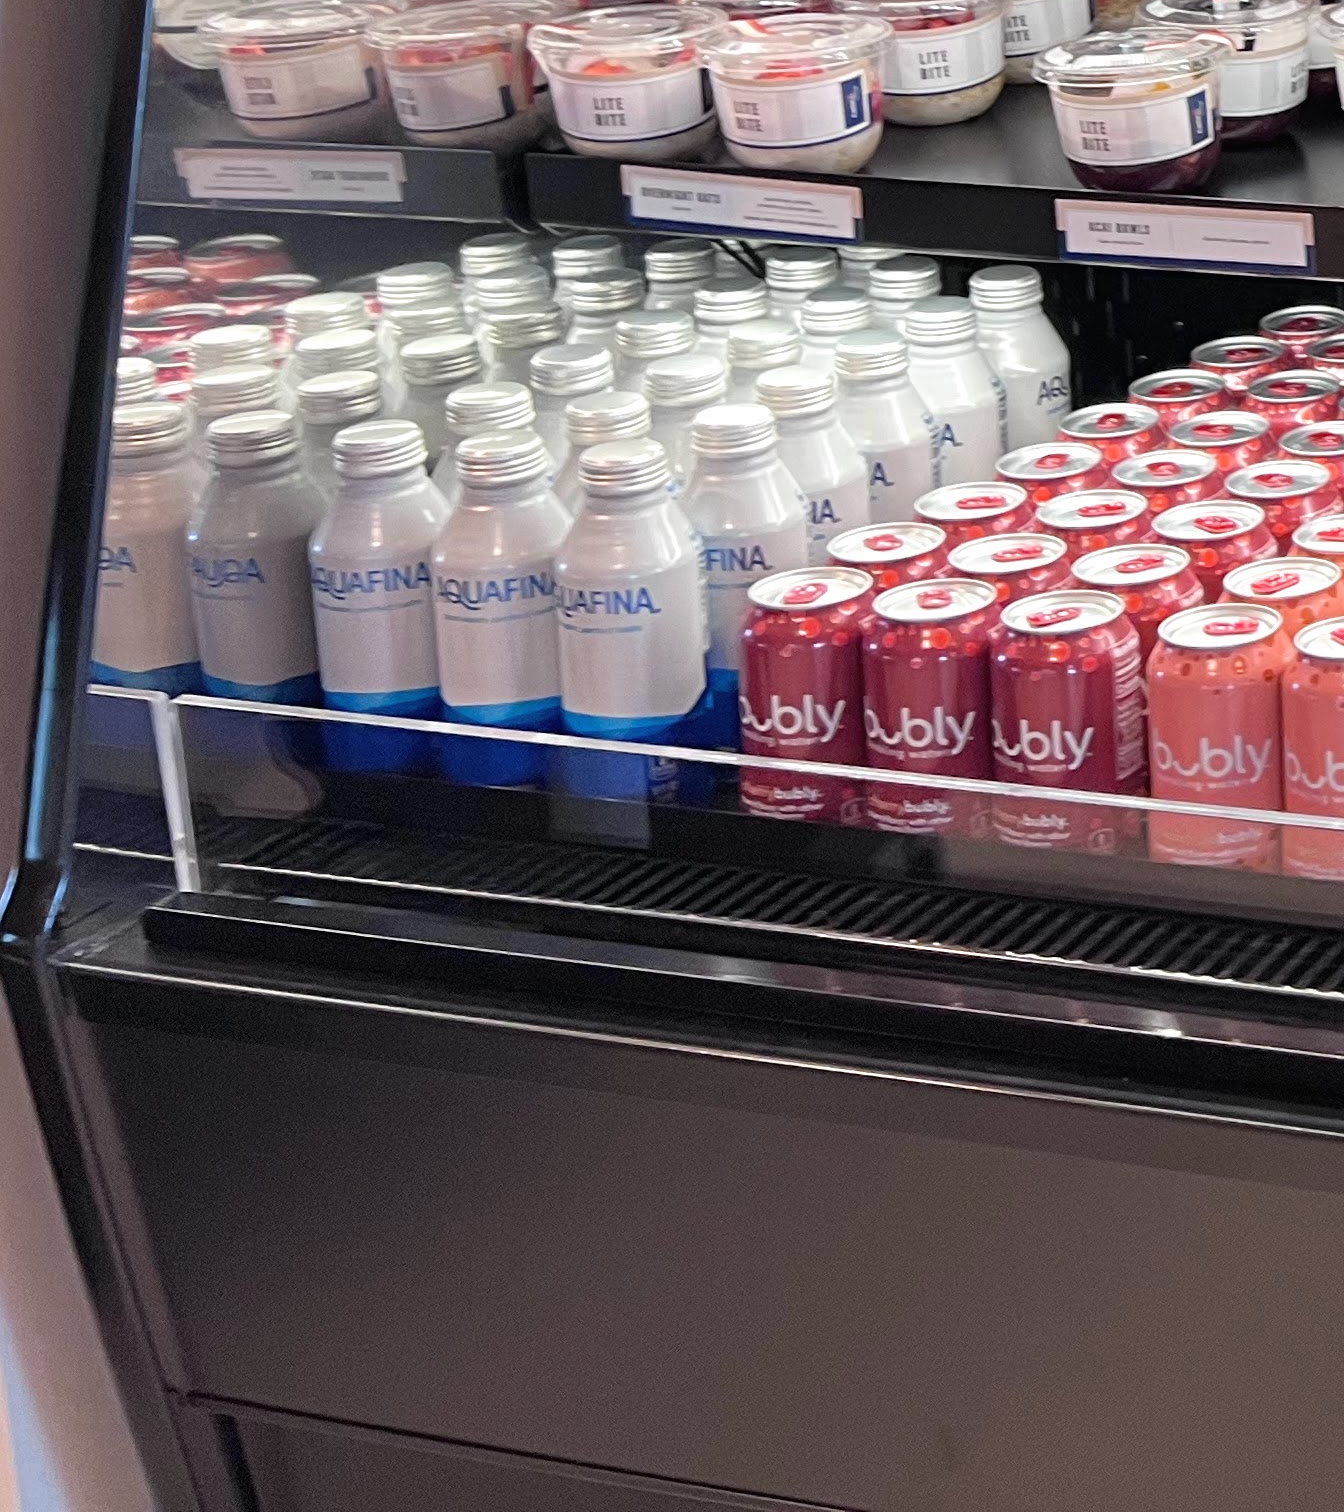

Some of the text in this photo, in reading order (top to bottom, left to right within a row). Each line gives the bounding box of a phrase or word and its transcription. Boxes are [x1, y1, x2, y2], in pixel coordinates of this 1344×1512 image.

[1005, 15, 1027, 29] ITE
[917, 50, 949, 65] LITE
[920, 64, 951, 80] BITE
[593, 97, 624, 111] LITE
[594, 112, 627, 127] BITE
[1080, 120, 1107, 135] LITE
[1082, 137, 1111, 152] BITE
[702, 544, 773, 572] FINA
[557, 587, 662, 618] UAFINA
[991, 719, 1095, 770] ubly
